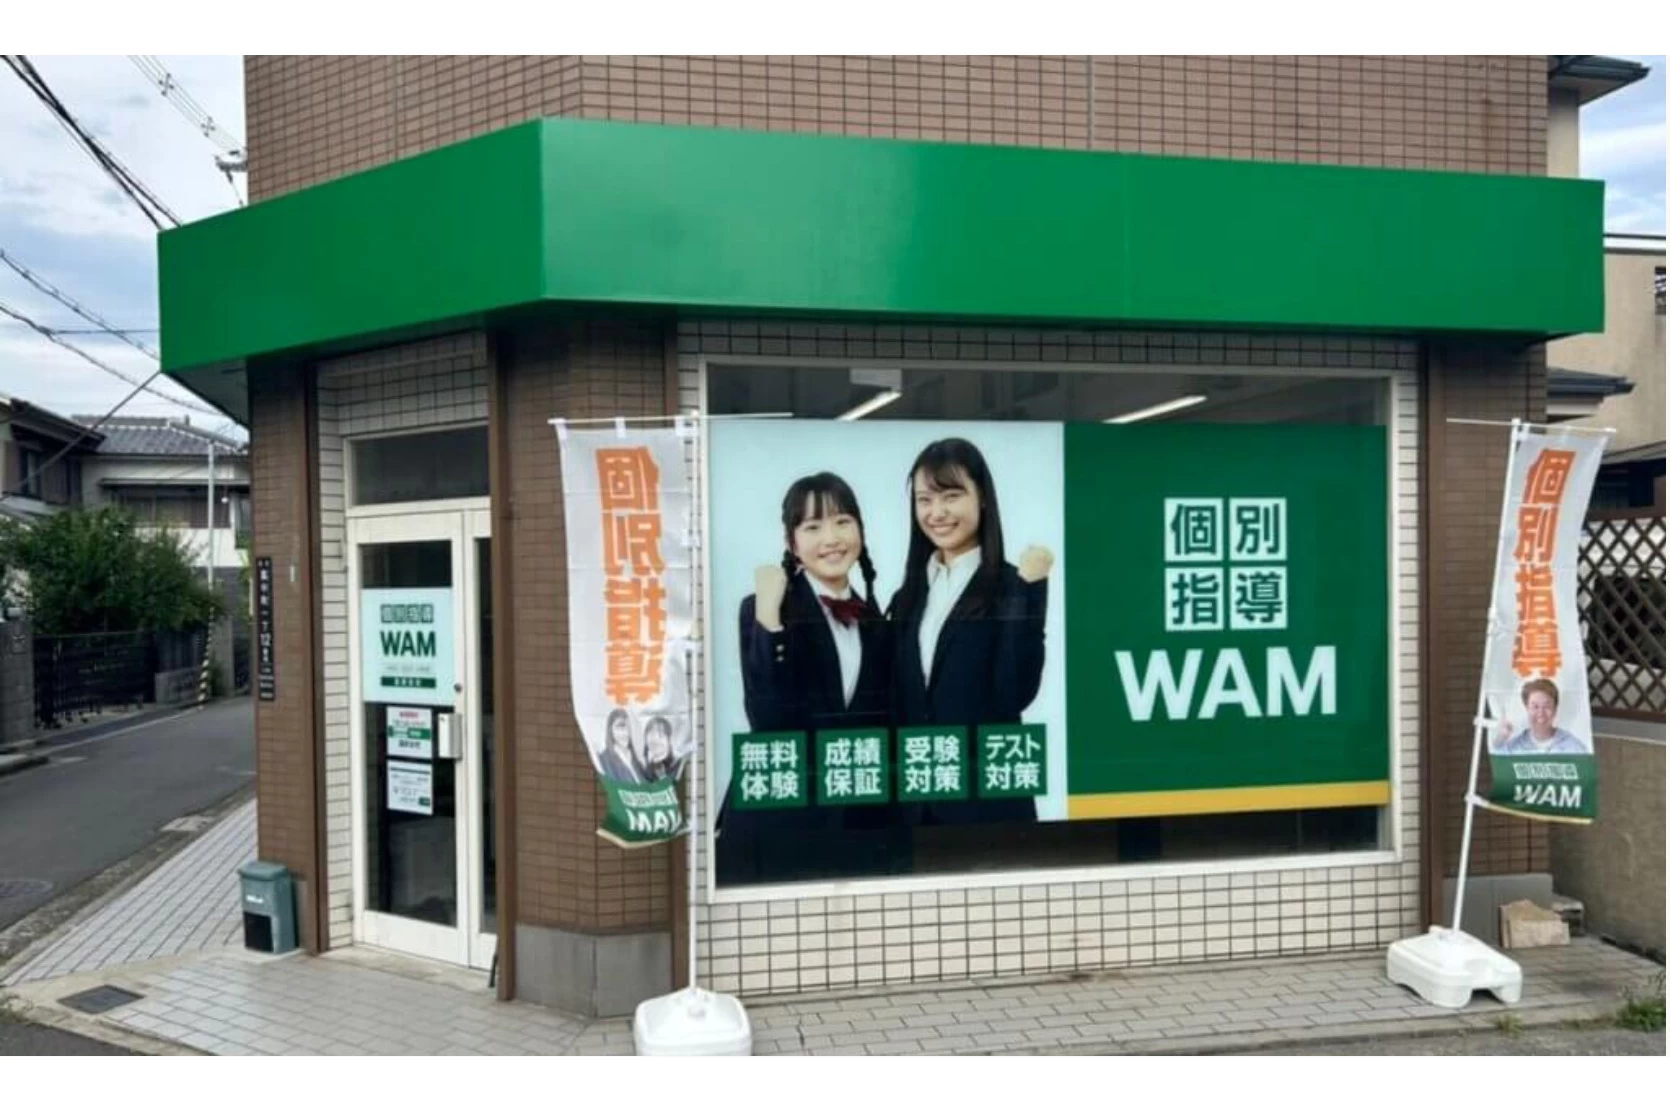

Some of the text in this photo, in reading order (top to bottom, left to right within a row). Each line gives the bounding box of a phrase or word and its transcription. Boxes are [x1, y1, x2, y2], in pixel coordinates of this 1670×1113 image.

[1170, 503, 1280, 556] 個別
[1511, 448, 1577, 678] 個別指導
[1171, 570, 1284, 625] 指導
[380, 630, 437, 658] WAM
[1114, 645, 1337, 722] WAM
[740, 739, 799, 770] 無料
[825, 737, 881, 767] 成績
[905, 735, 961, 765] 受験
[985, 733, 1041, 760] テスト
[740, 769, 799, 802] 体験
[824, 766, 882, 798] 保証
[905, 763, 961, 794] 対策
[985, 761, 1041, 791] 対策
[1514, 784, 1582, 810] WAM
